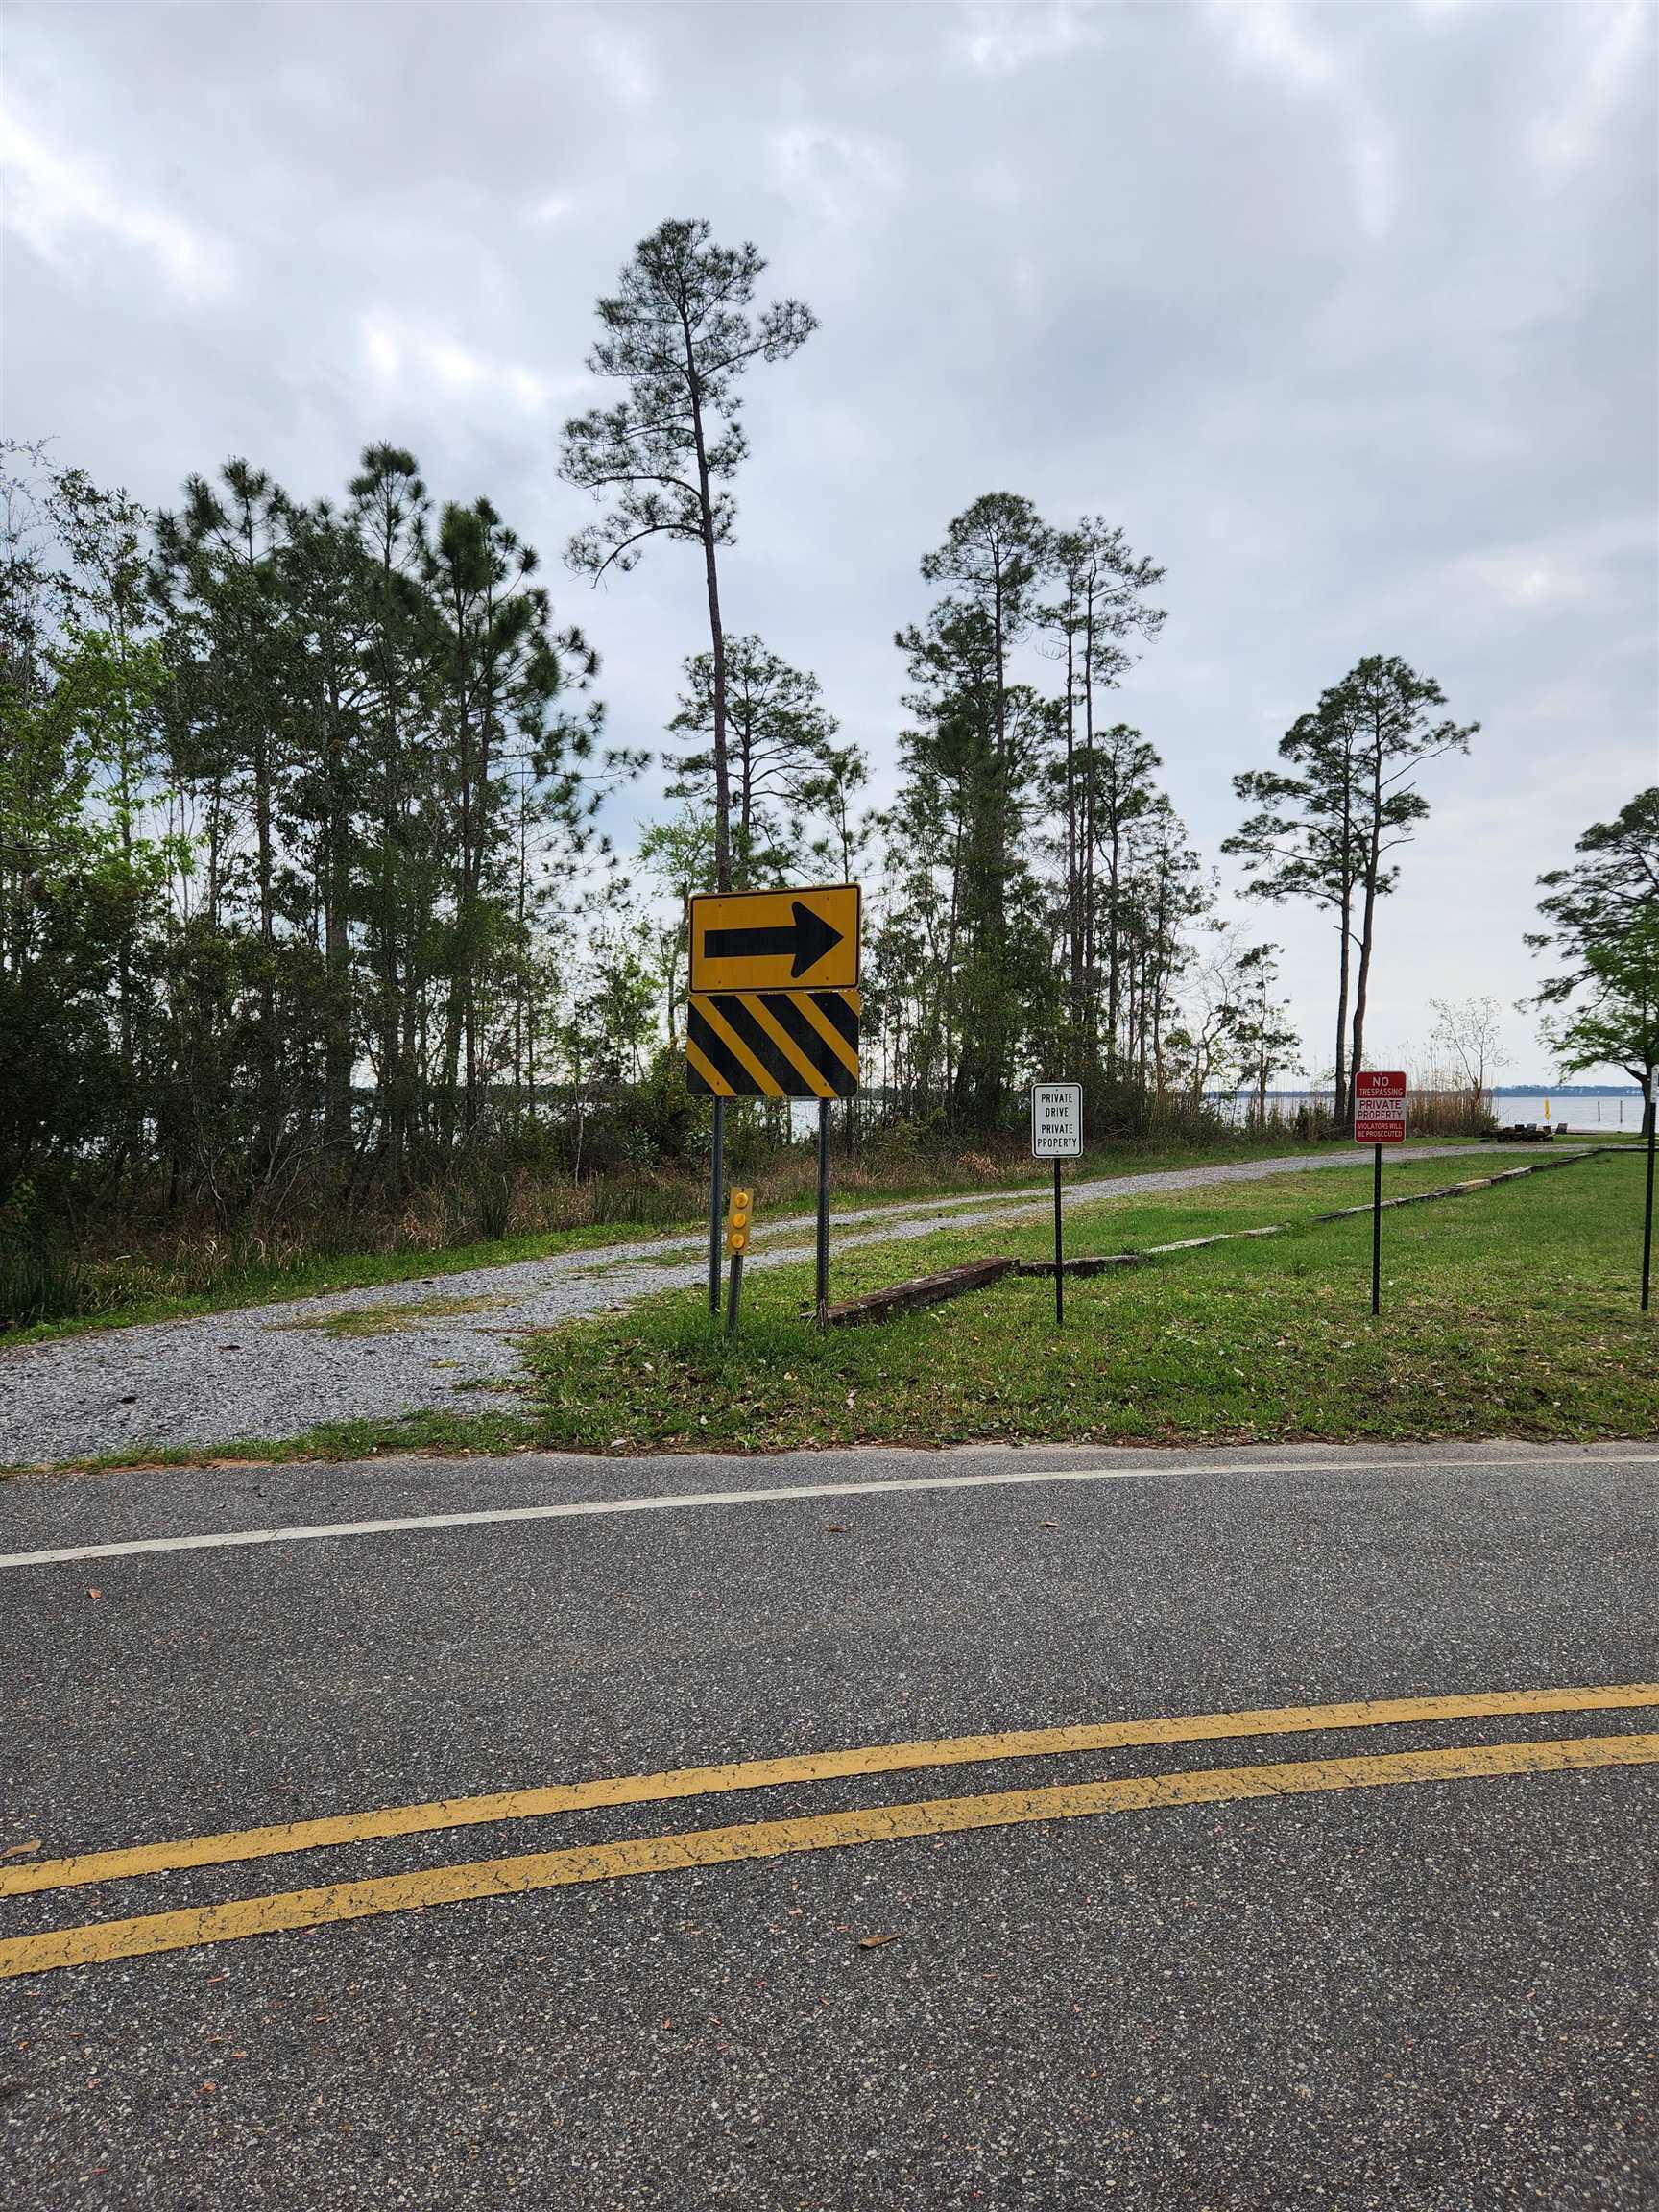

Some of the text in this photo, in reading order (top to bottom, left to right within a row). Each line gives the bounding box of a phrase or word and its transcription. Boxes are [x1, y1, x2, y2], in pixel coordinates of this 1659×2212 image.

[1372, 1076, 1389, 1087] NO
[1359, 1088, 1403, 1096] TRESPASSING
[1041, 1093, 1073, 1103] PRIVATE
[1359, 1099, 1402, 1109] PRIVATE
[1046, 1107, 1069, 1117] DRIVE
[1358, 1110, 1403, 1119] PROPERTY
[1041, 1123, 1073, 1134] PRIVATE
[1037, 1138, 1077, 1148] PROPERTY
